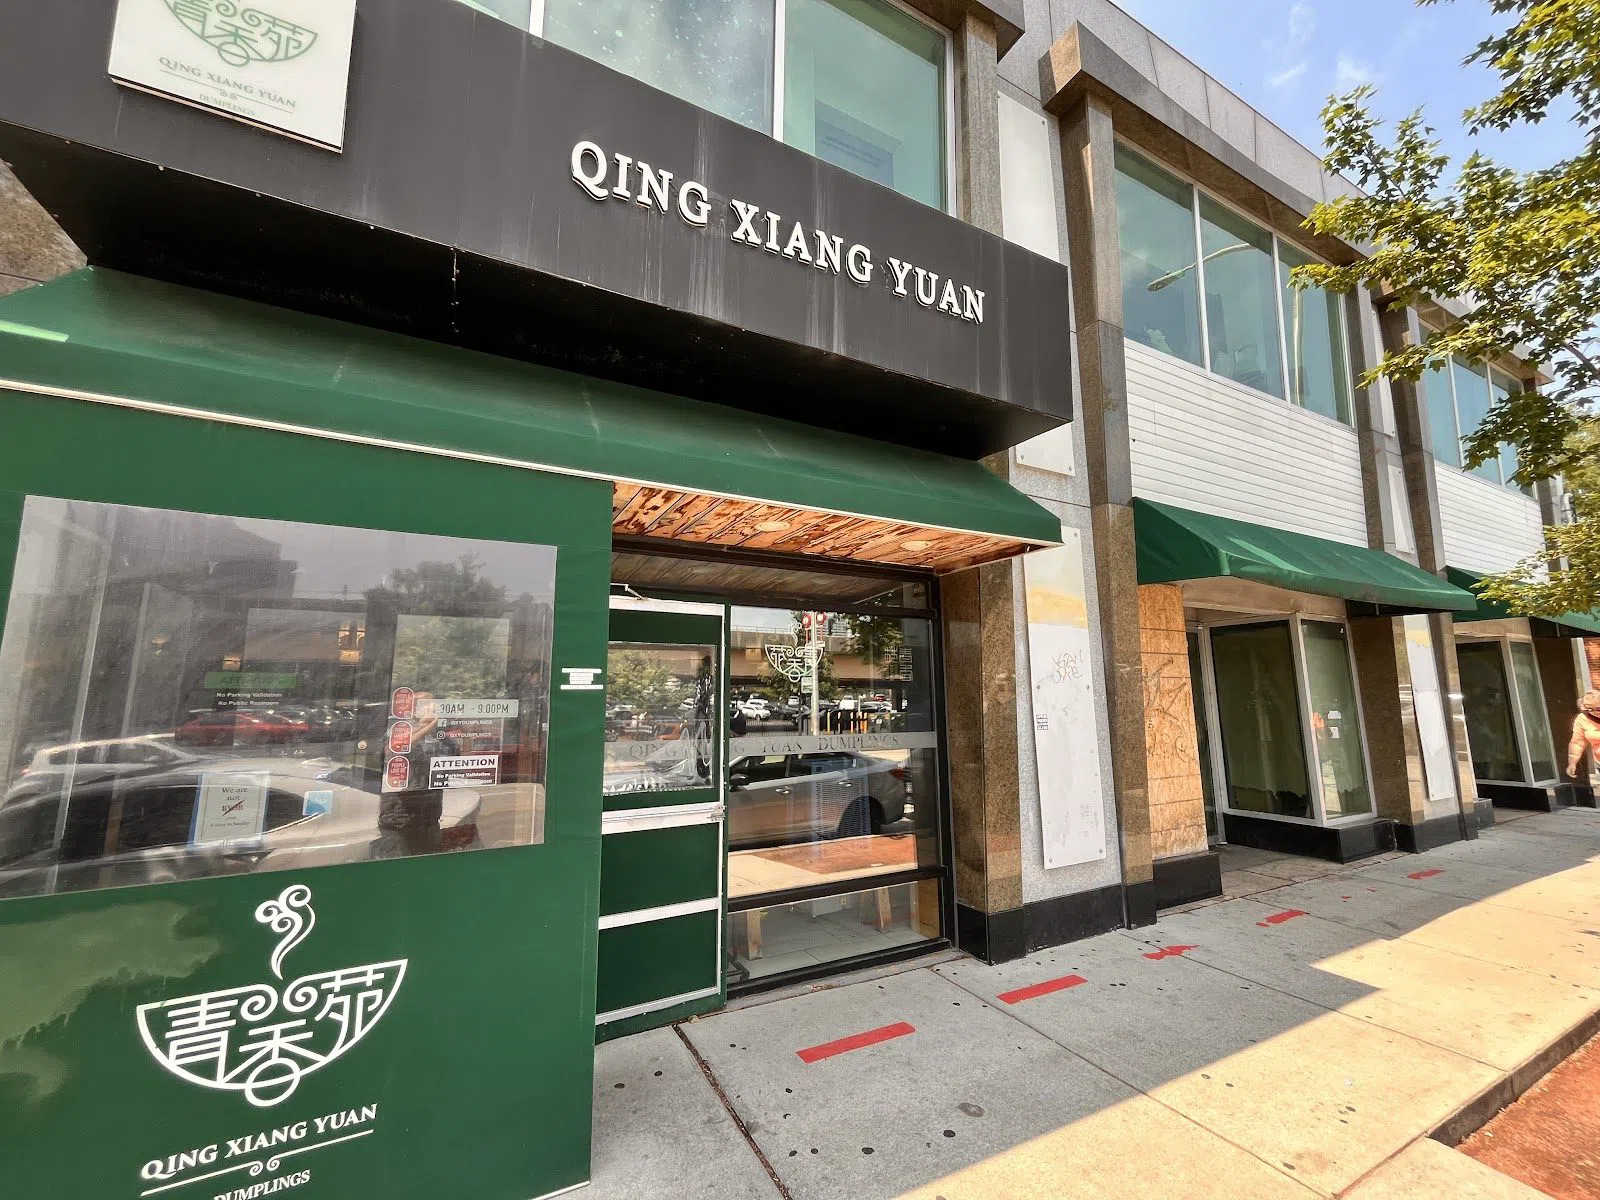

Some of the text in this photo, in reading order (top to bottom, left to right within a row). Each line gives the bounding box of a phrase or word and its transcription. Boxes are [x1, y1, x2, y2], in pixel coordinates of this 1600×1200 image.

[159, 56, 296, 108] QING XIANG YUAN
[199, 93, 256, 117] DUMPLINGS
[571, 140, 986, 324] QING XIANG YUAN
[477, 703, 509, 714] 9:00PM
[433, 758, 495, 769] ATTENTION
[141, 1103, 378, 1180] QING XIANG YUAN
